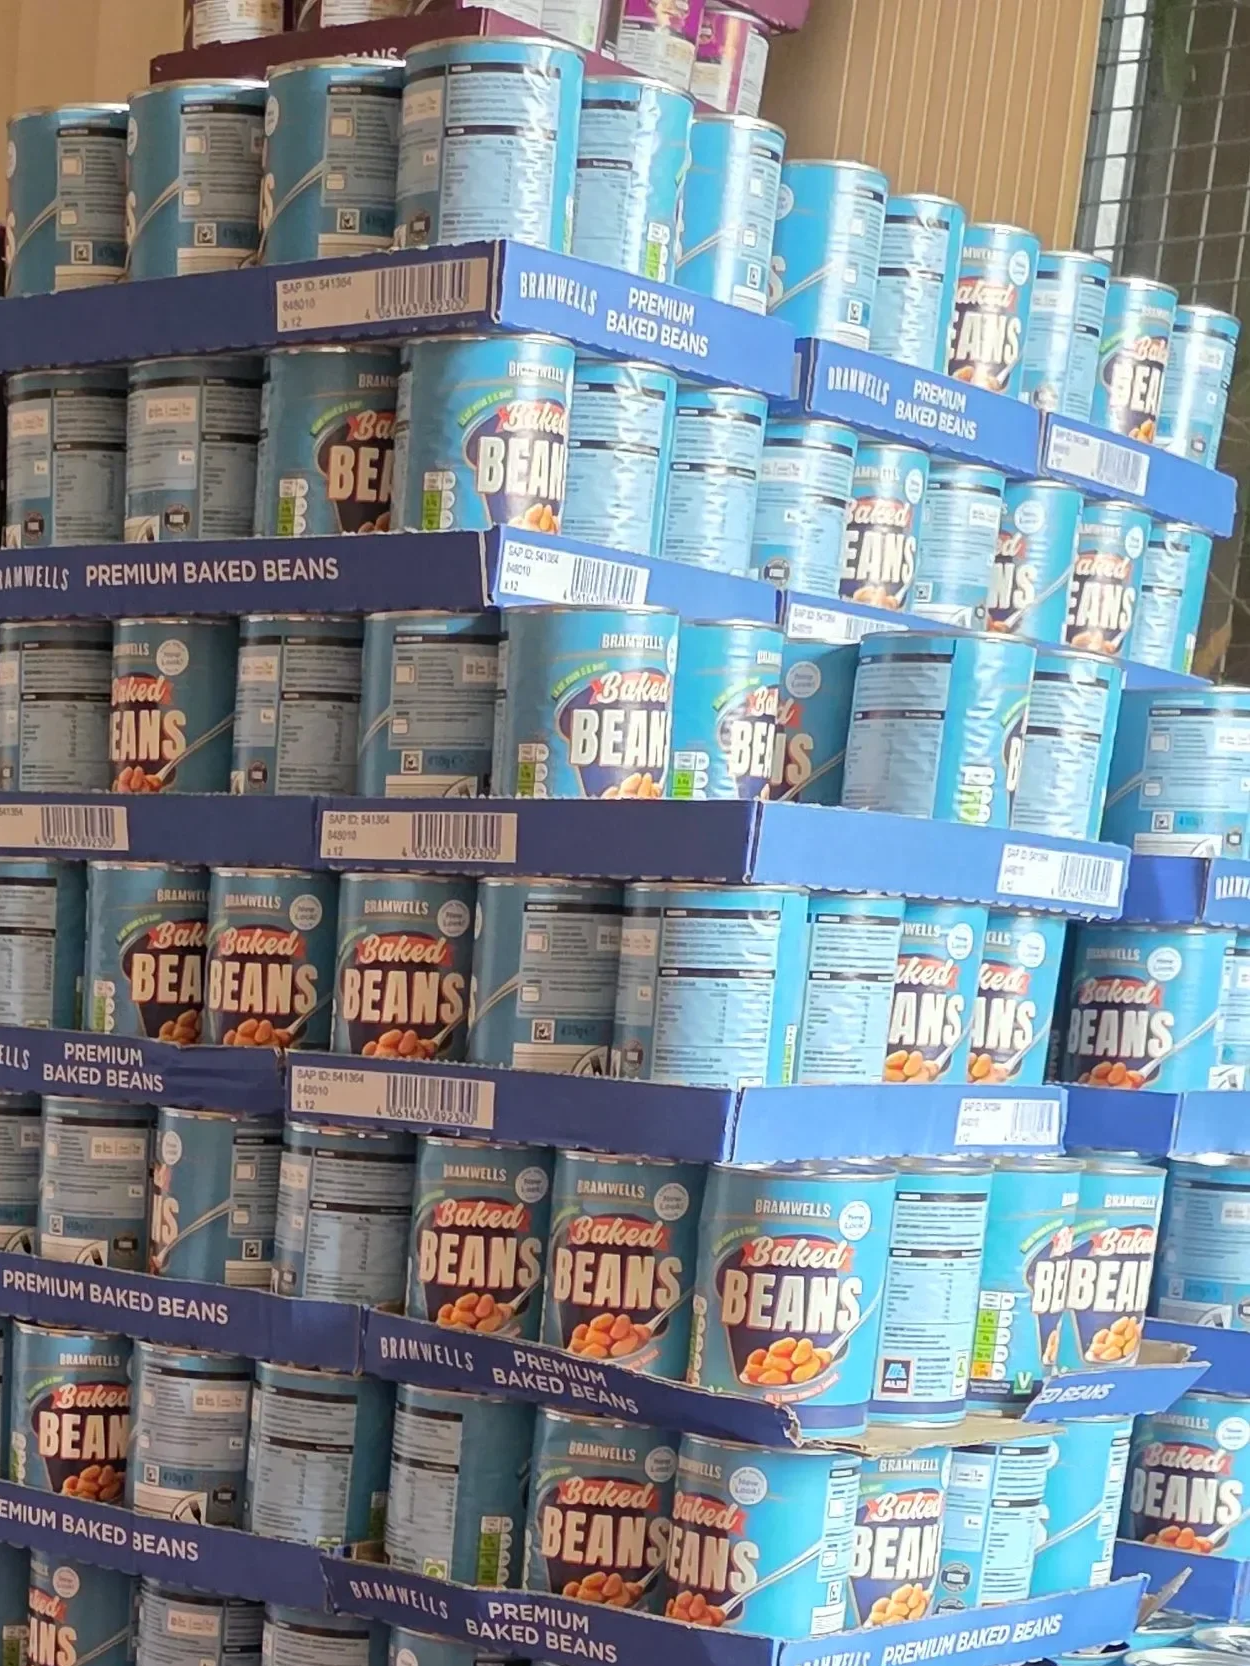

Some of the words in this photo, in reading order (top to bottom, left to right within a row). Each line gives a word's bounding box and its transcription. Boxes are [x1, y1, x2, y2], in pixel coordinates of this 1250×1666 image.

[519, 272, 598, 317] BRAMWELLS
[628, 286, 695, 327] PREMIUM
[606, 315, 657, 342] BAKED
[660, 328, 708, 358] BEANS
[828, 365, 891, 406] BRAMWELLS
[913, 379, 967, 413] PREMIUM
[895, 401, 937, 429] BAKED
[939, 410, 976, 441] BEANS
[85, 561, 176, 588] PREMIUM
[184, 560, 256, 585] BAKED
[262, 558, 339, 582] BEANS
[224, 895, 281, 911] BRAMWELLS
[364, 900, 429, 916] BRAMWELLS
[221, 927, 300, 955] Baked
[360, 933, 448, 964] Baked
[1085, 948, 1140, 962] BRAMWELLS
[208, 960, 318, 1015] BEANS
[343, 967, 465, 1025] BEANS
[1080, 979, 1157, 1005] Baked
[1066, 1009, 1175, 1059] BEANS
[64, 1043, 144, 1068] PREMIUM
[43, 1063, 102, 1086] BAKED
[105, 1068, 164, 1093] BEANS
[576, 1179, 645, 1199] BRAMWELLS
[755, 1200, 831, 1218] BRAMWELLS
[572, 1216, 664, 1248] Baked
[751, 1235, 848, 1268] Baked
[553, 1246, 684, 1311] BEANS
[2, 1270, 85, 1302] PREMIUM
[90, 1283, 153, 1313] BAKED
[157, 1295, 229, 1325] BEANS
[721, 1273, 864, 1334] BEANS
[350, 1580, 448, 1620] BRAMWELLS
[488, 1601, 590, 1634] PREMIUM
[955, 1625, 1008, 1655] BAKED
[1012, 1614, 1062, 1646] BEANS
[465, 1620, 538, 1646] BAKED
[545, 1632, 618, 1663] BEANS
